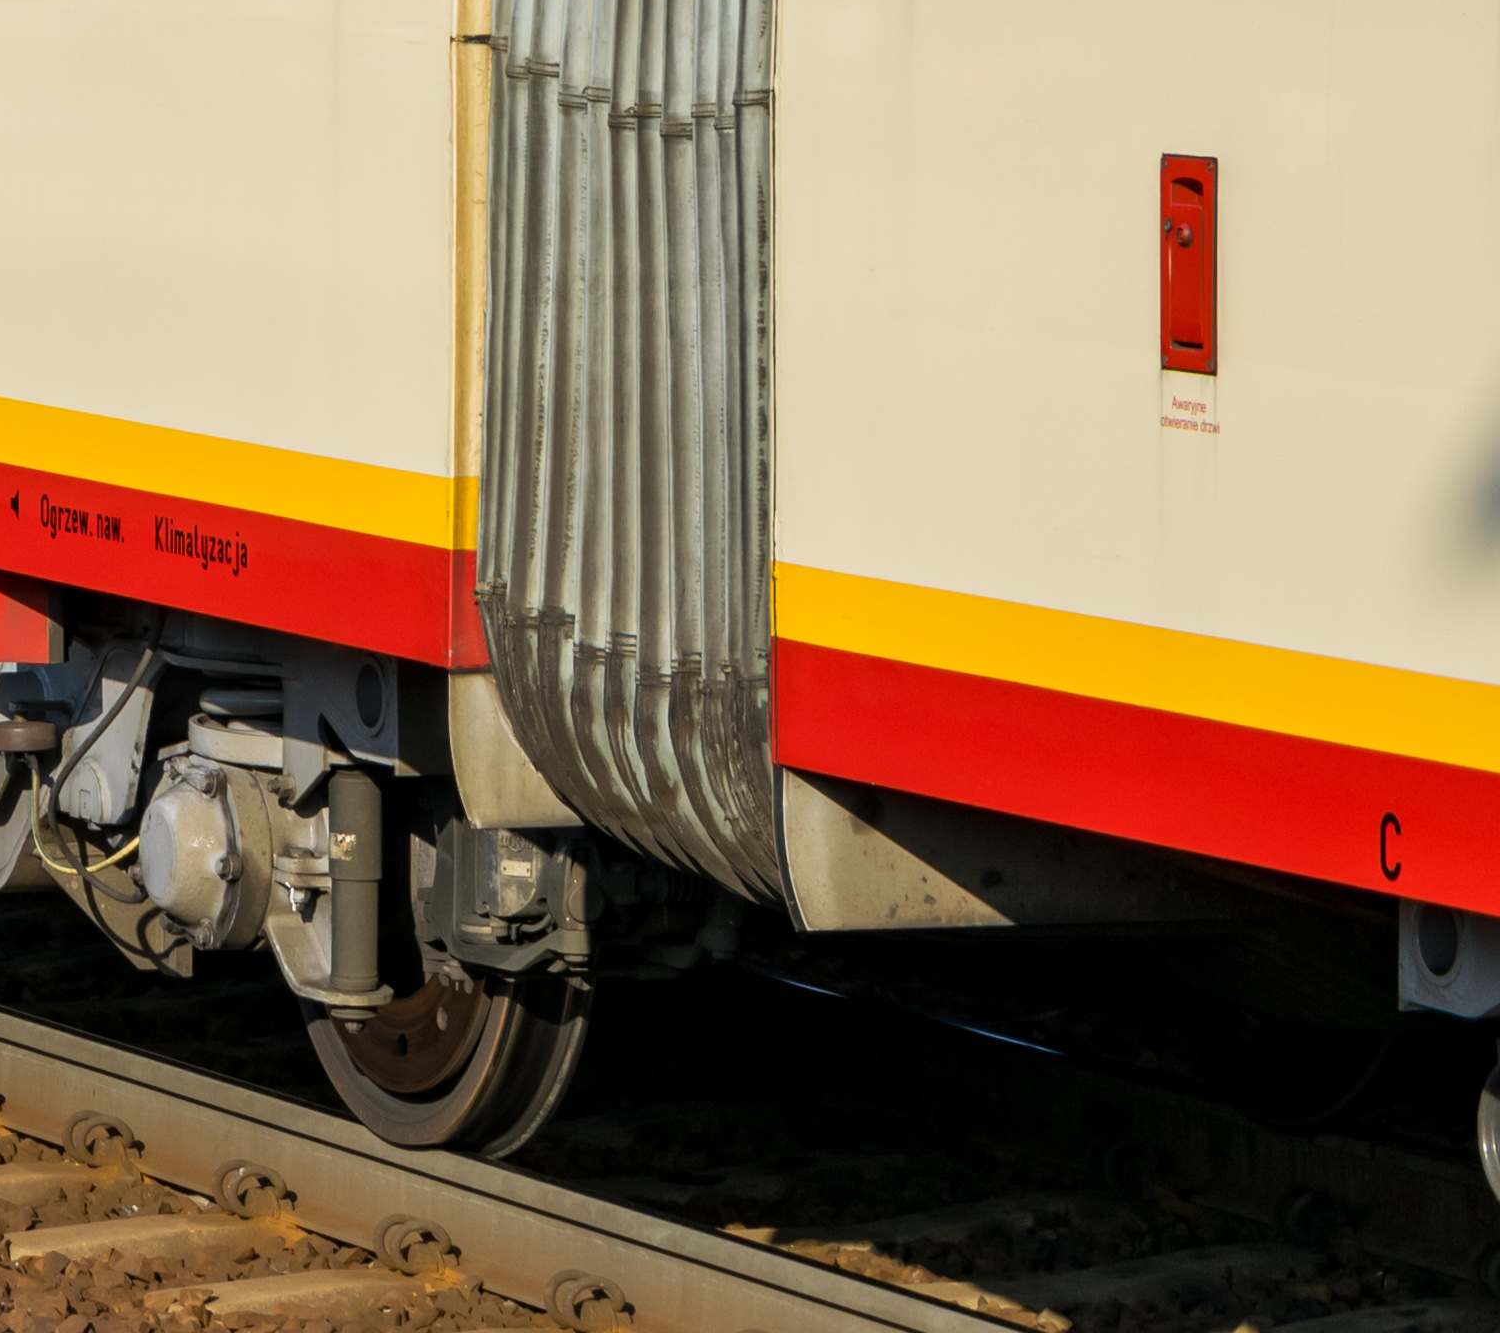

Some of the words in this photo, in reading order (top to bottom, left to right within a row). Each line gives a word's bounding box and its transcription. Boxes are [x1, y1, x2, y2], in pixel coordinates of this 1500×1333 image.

[1160, 414, 1199, 432] otwieranie
[1200, 419, 1221, 434] drzwi
[1171, 396, 1207, 416] Awaryjne
[40, 493, 93, 540] Ogrzew.
[96, 513, 125, 544] naw.
[154, 515, 248, 577] Klimatyzacja
[1379, 811, 1402, 884] C
